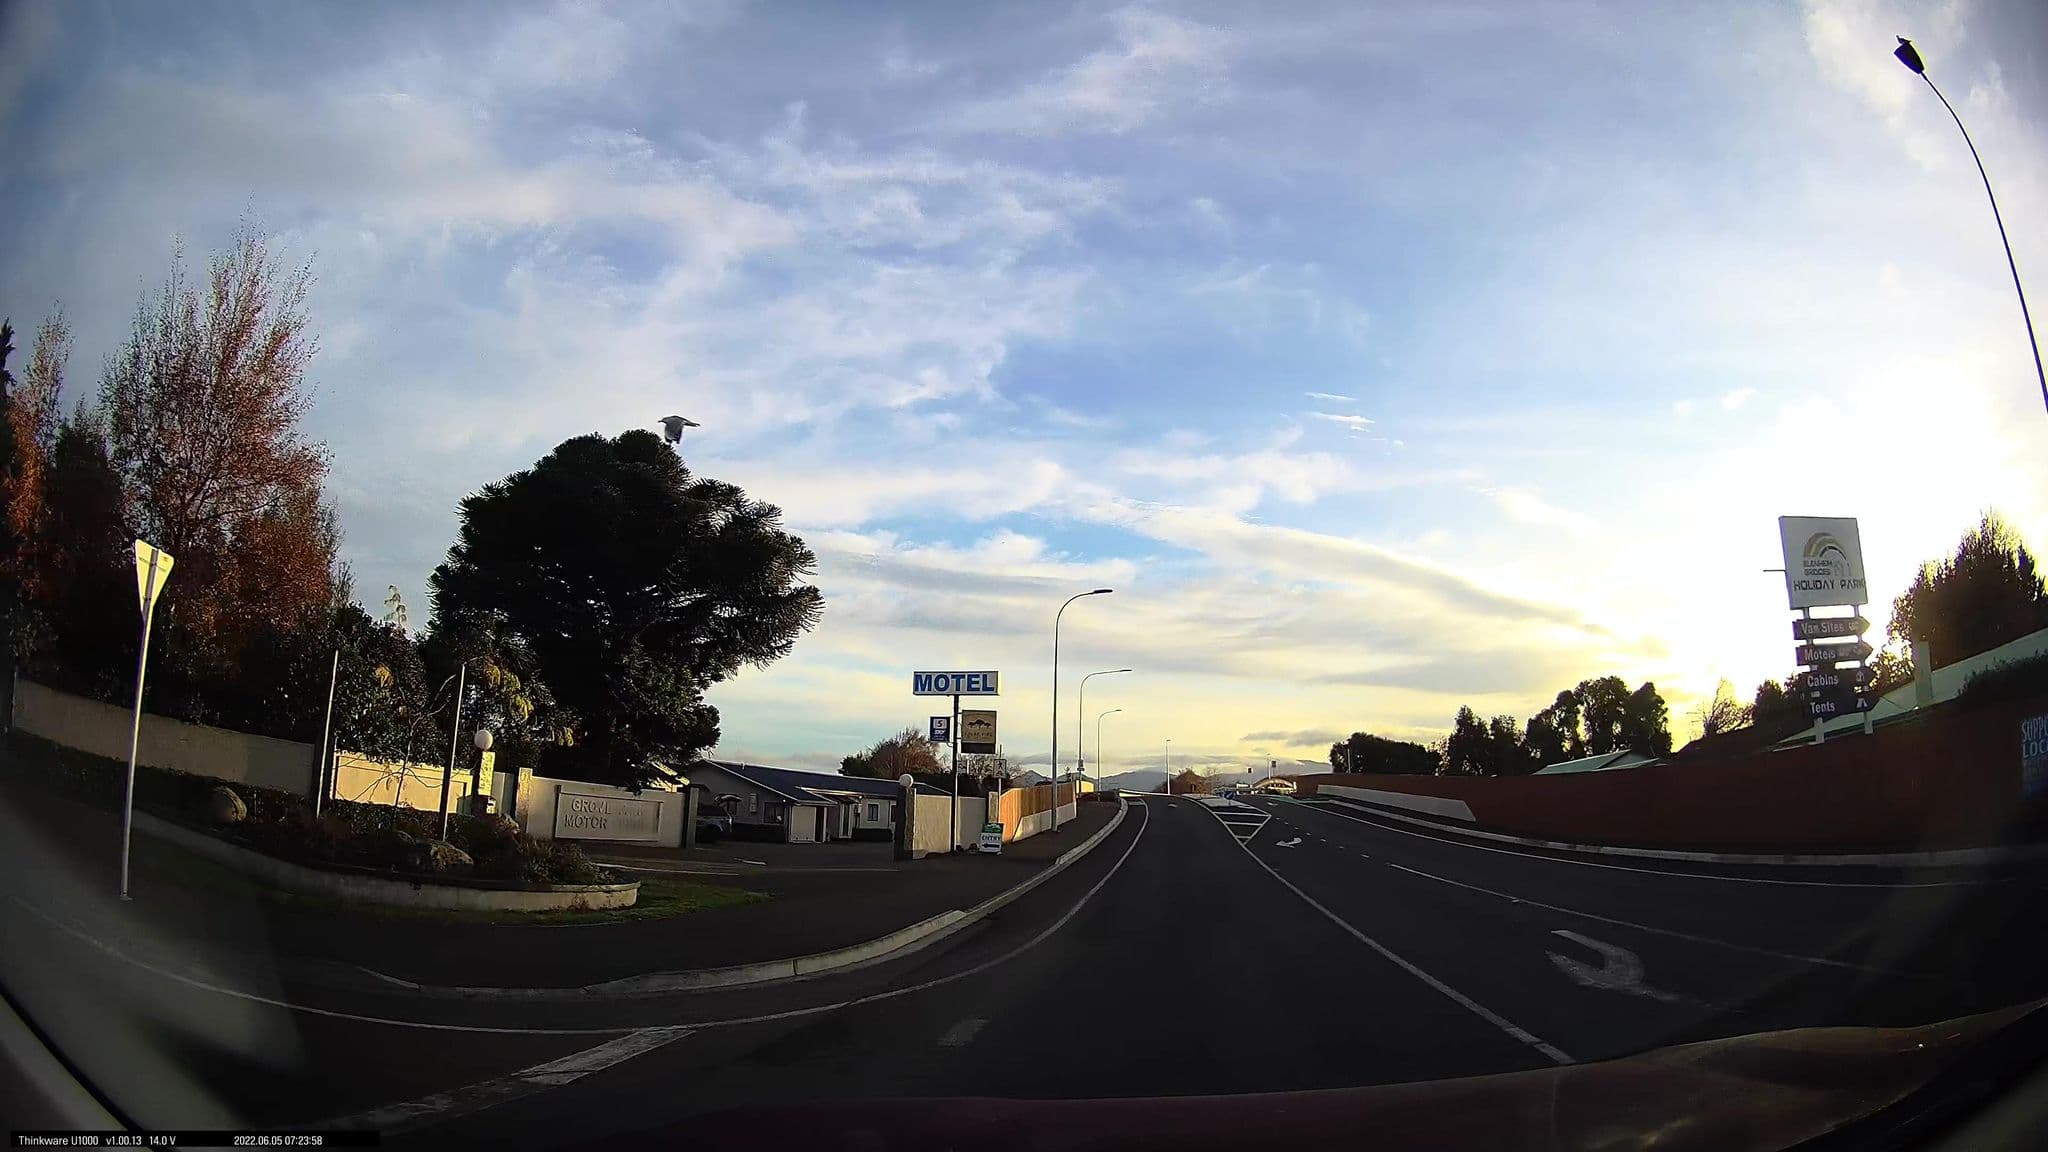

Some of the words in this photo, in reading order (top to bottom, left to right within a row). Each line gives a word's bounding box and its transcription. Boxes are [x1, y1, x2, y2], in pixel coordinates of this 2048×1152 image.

[1793, 579, 1835, 591] HOLIDAY
[1840, 579, 1865, 589] PARK
[1801, 622, 1819, 634] Van
[1821, 621, 1845, 633] Sites
[1804, 648, 1836, 661] Motels
[914, 674, 995, 692] MOTEL
[1807, 674, 1839, 687] Cabins
[1809, 700, 1835, 714] Tents
[2023, 739, 2048, 758] LOC
[564, 814, 608, 830] MOTOR
